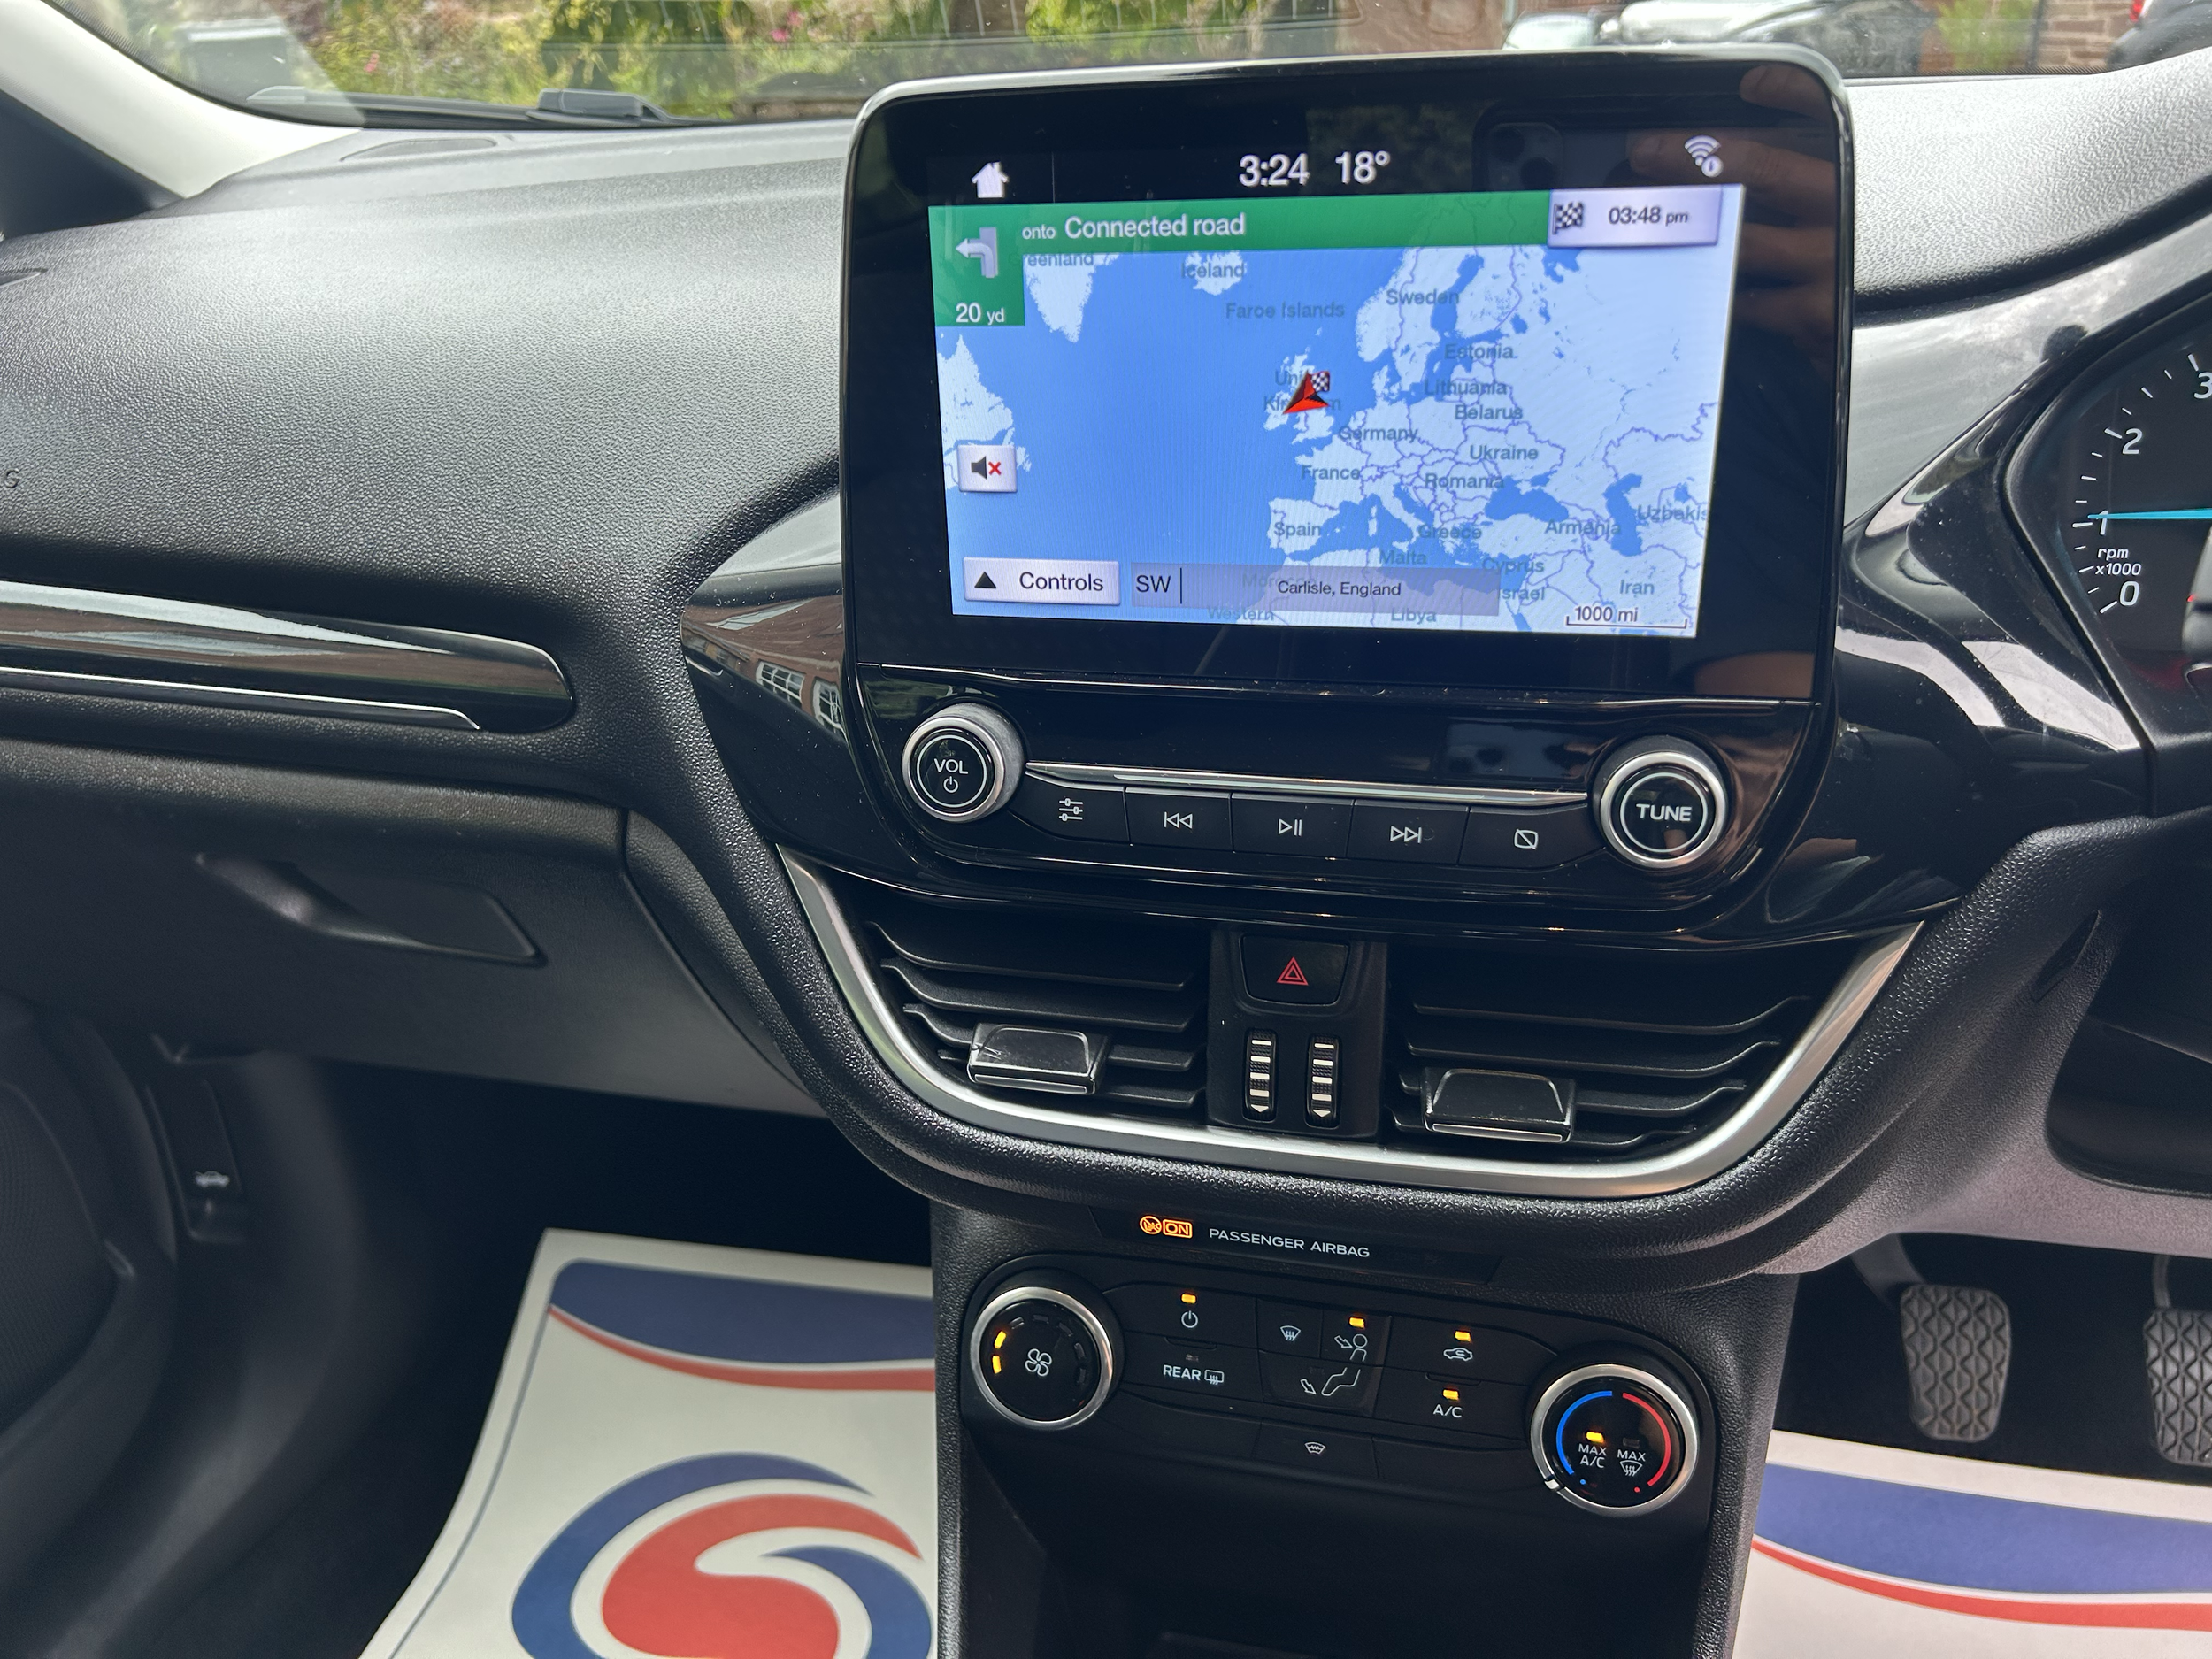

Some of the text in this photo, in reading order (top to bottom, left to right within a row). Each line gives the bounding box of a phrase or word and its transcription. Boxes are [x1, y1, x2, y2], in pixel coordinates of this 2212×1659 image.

[1238, 154, 1310, 187] 3:24
[1608, 206, 1689, 227] 03:48 pm
[1022, 212, 1246, 240] onto Connected road
[1182, 262, 1245, 280] Iceland
[1386, 288, 1460, 306] Sweden
[956, 303, 1005, 326] 20 yd
[1225, 301, 1345, 319] Faroe Islands
[1445, 343, 1514, 359] Estonia
[1425, 379, 1508, 396] Lithuania
[2193, 372, 2212, 400] 3
[1455, 404, 1523, 420] Belarus
[1339, 426, 1417, 444] Germany
[2122, 428, 2143, 455] 2
[1469, 445, 1539, 460] Ukraine
[1301, 465, 1361, 480] France
[1425, 472, 1504, 488] Romania
[1273, 522, 1322, 540] Spain
[1417, 523, 1482, 540] Greece
[1544, 519, 1622, 535] Armenia
[2098, 510, 2109, 536] 1
[1379, 549, 1428, 565] Malta
[2097, 547, 2129, 561] rpm
[1482, 557, 1545, 574] Cyprus
[2094, 562, 2142, 576] x1000
[1018, 572, 1104, 593] Controls
[1135, 574, 1171, 594] SW
[1277, 580, 1402, 598] Carlisle, England
[1619, 579, 1655, 595] Iran
[2119, 580, 2140, 606] 0
[1390, 608, 1437, 625] Libya
[1574, 605, 1639, 623] 1000 mi
[933, 757, 969, 775] VOL
[1635, 802, 1694, 823] TUNE
[1164, 1223, 1191, 1237] ON
[1209, 1227, 1371, 1258] PASSENGER AIRBAG
[1163, 1364, 1202, 1382] REAR
[1432, 1403, 1463, 1419] A/C
[1578, 1443, 1608, 1457] MAX
[1617, 1448, 1647, 1462] MAX
[1579, 1455, 1606, 1470] A/C
